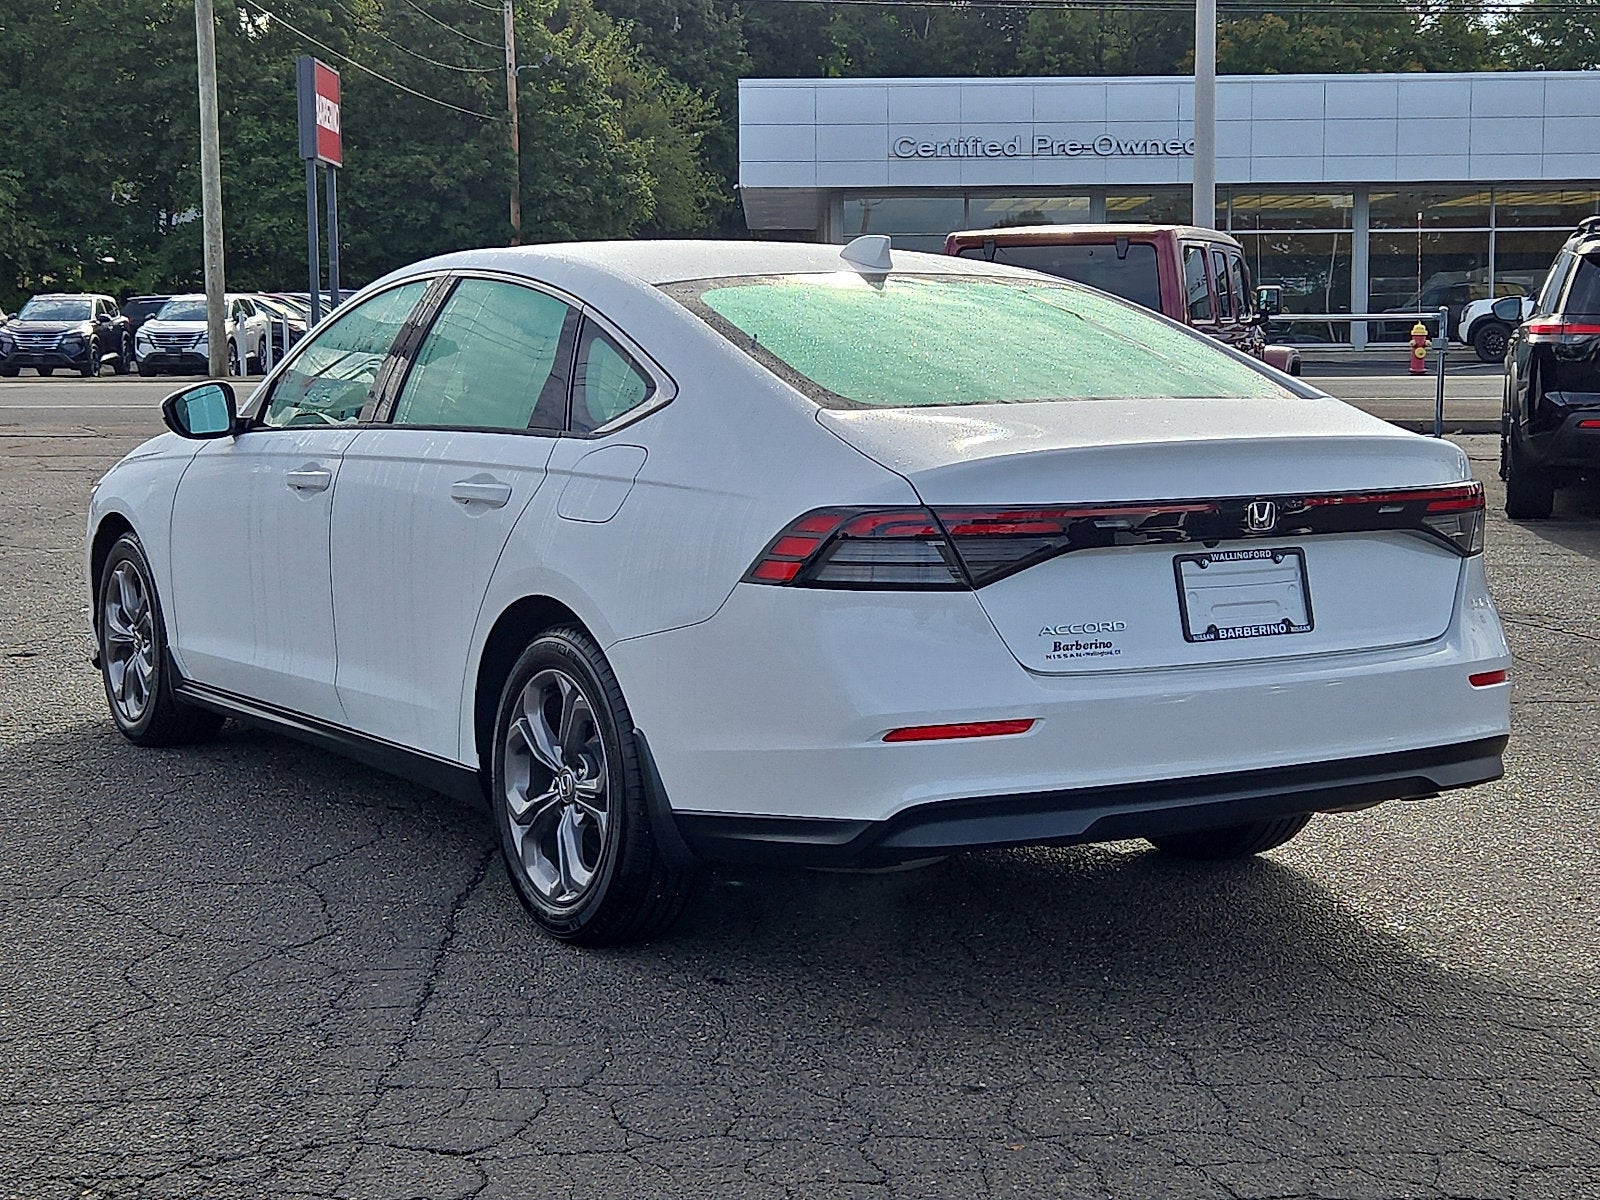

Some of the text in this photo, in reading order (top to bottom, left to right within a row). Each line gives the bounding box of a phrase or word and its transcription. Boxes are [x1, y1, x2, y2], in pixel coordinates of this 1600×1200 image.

[894, 136, 1021, 158] Certified
[1211, 550, 1272, 562] WALLINGFORD
[1039, 621, 1127, 636] ACCORD
[1218, 624, 1287, 639] BARBERINO
[1052, 639, 1113, 652] Barberino
